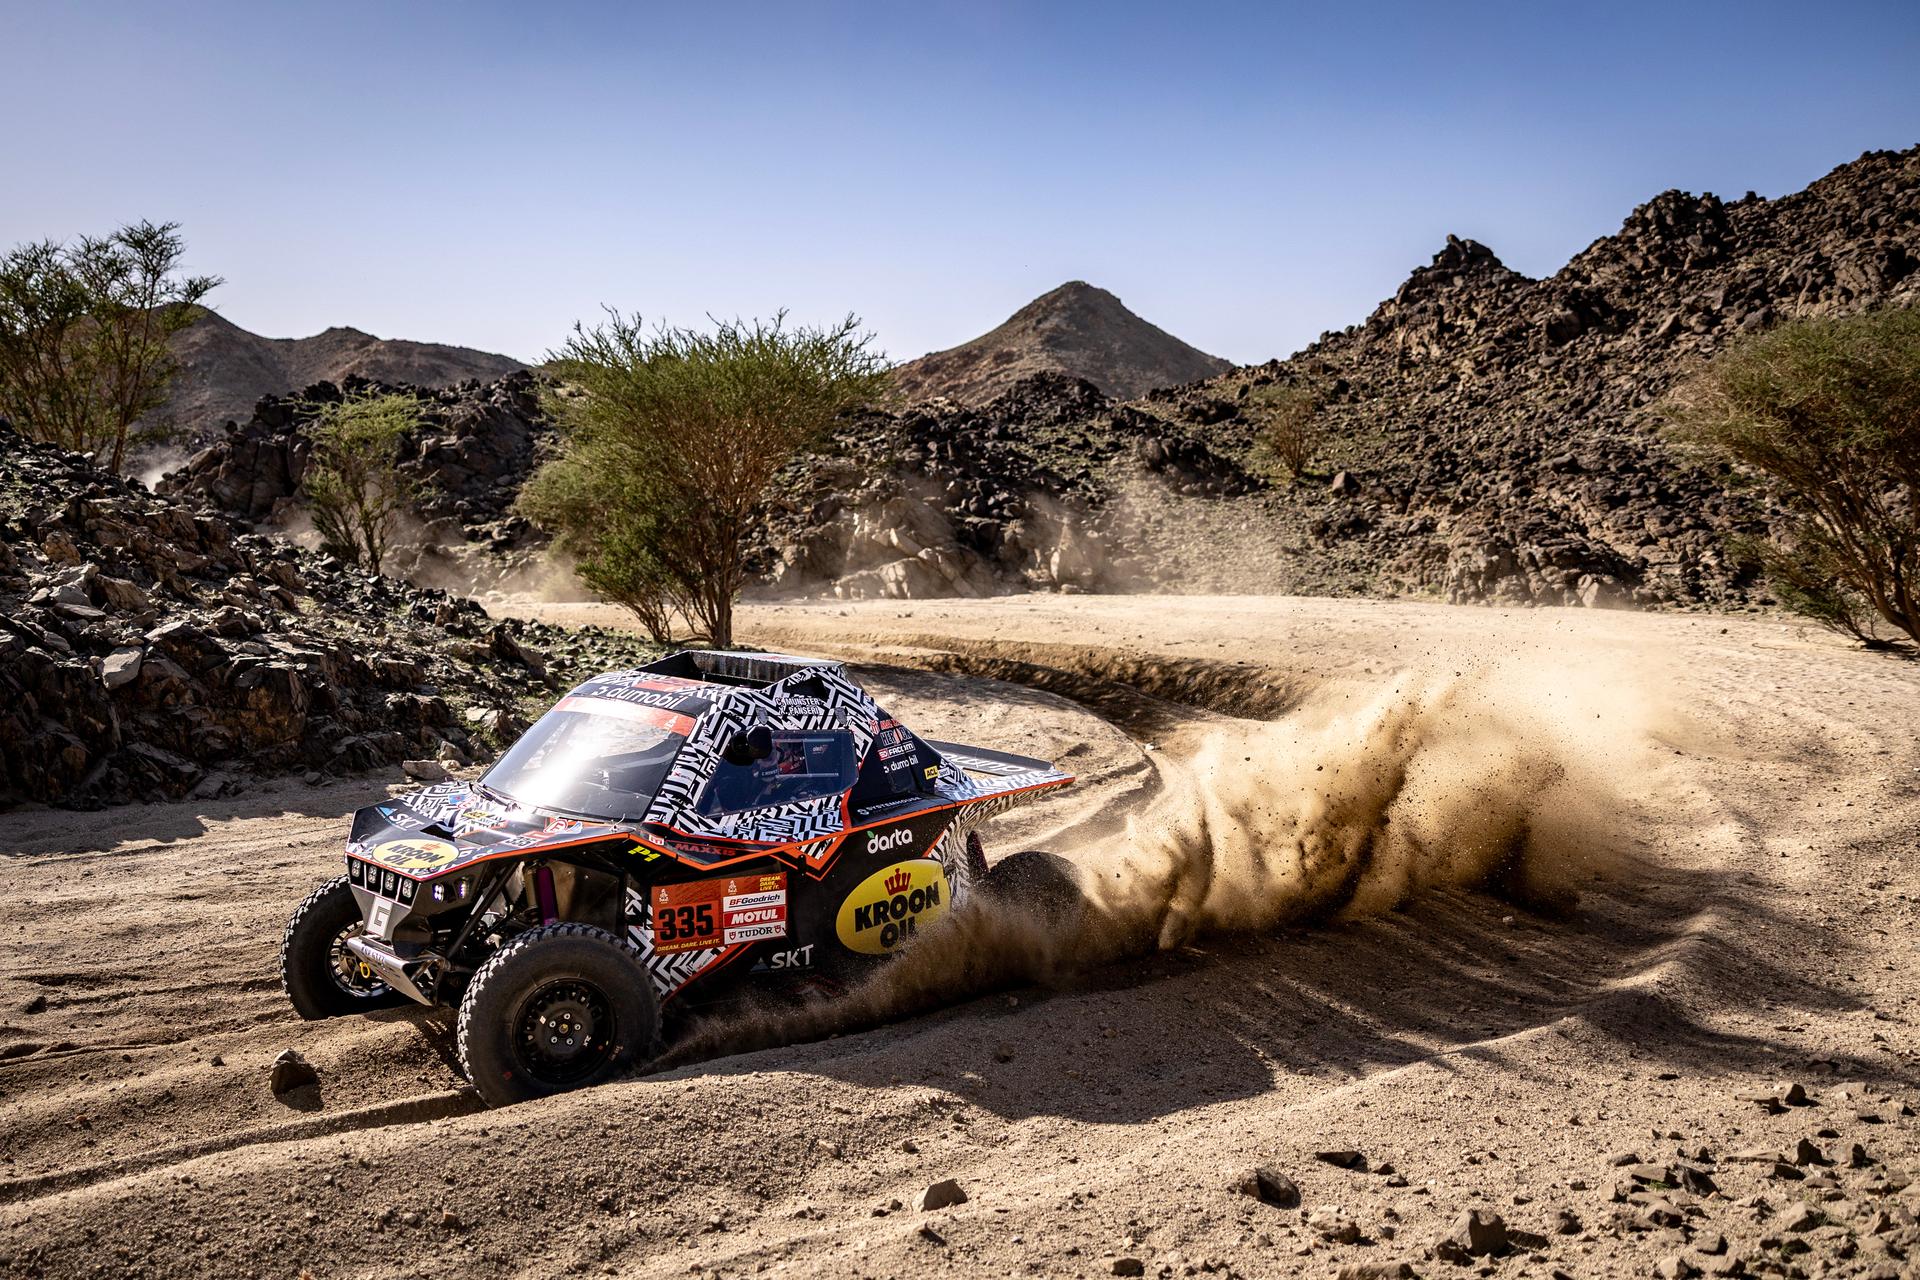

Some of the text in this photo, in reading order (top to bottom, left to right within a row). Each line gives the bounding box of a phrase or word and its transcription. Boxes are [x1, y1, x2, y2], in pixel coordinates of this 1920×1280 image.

[607, 686, 689, 709] dumobil
[389, 813, 425, 831] SKT
[674, 843, 737, 856] MAXXIS
[867, 828, 913, 854] darta
[387, 844, 445, 863] KROON
[729, 894, 780, 906] BFGoodrich
[854, 881, 940, 932] KROON
[658, 903, 714, 941] 335
[731, 909, 778, 925] MOTUL
[738, 926, 773, 938] TUDOR
[657, 944, 680, 952] DREAM.
[681, 941, 698, 949] DARE.
[770, 944, 814, 969] SKT
